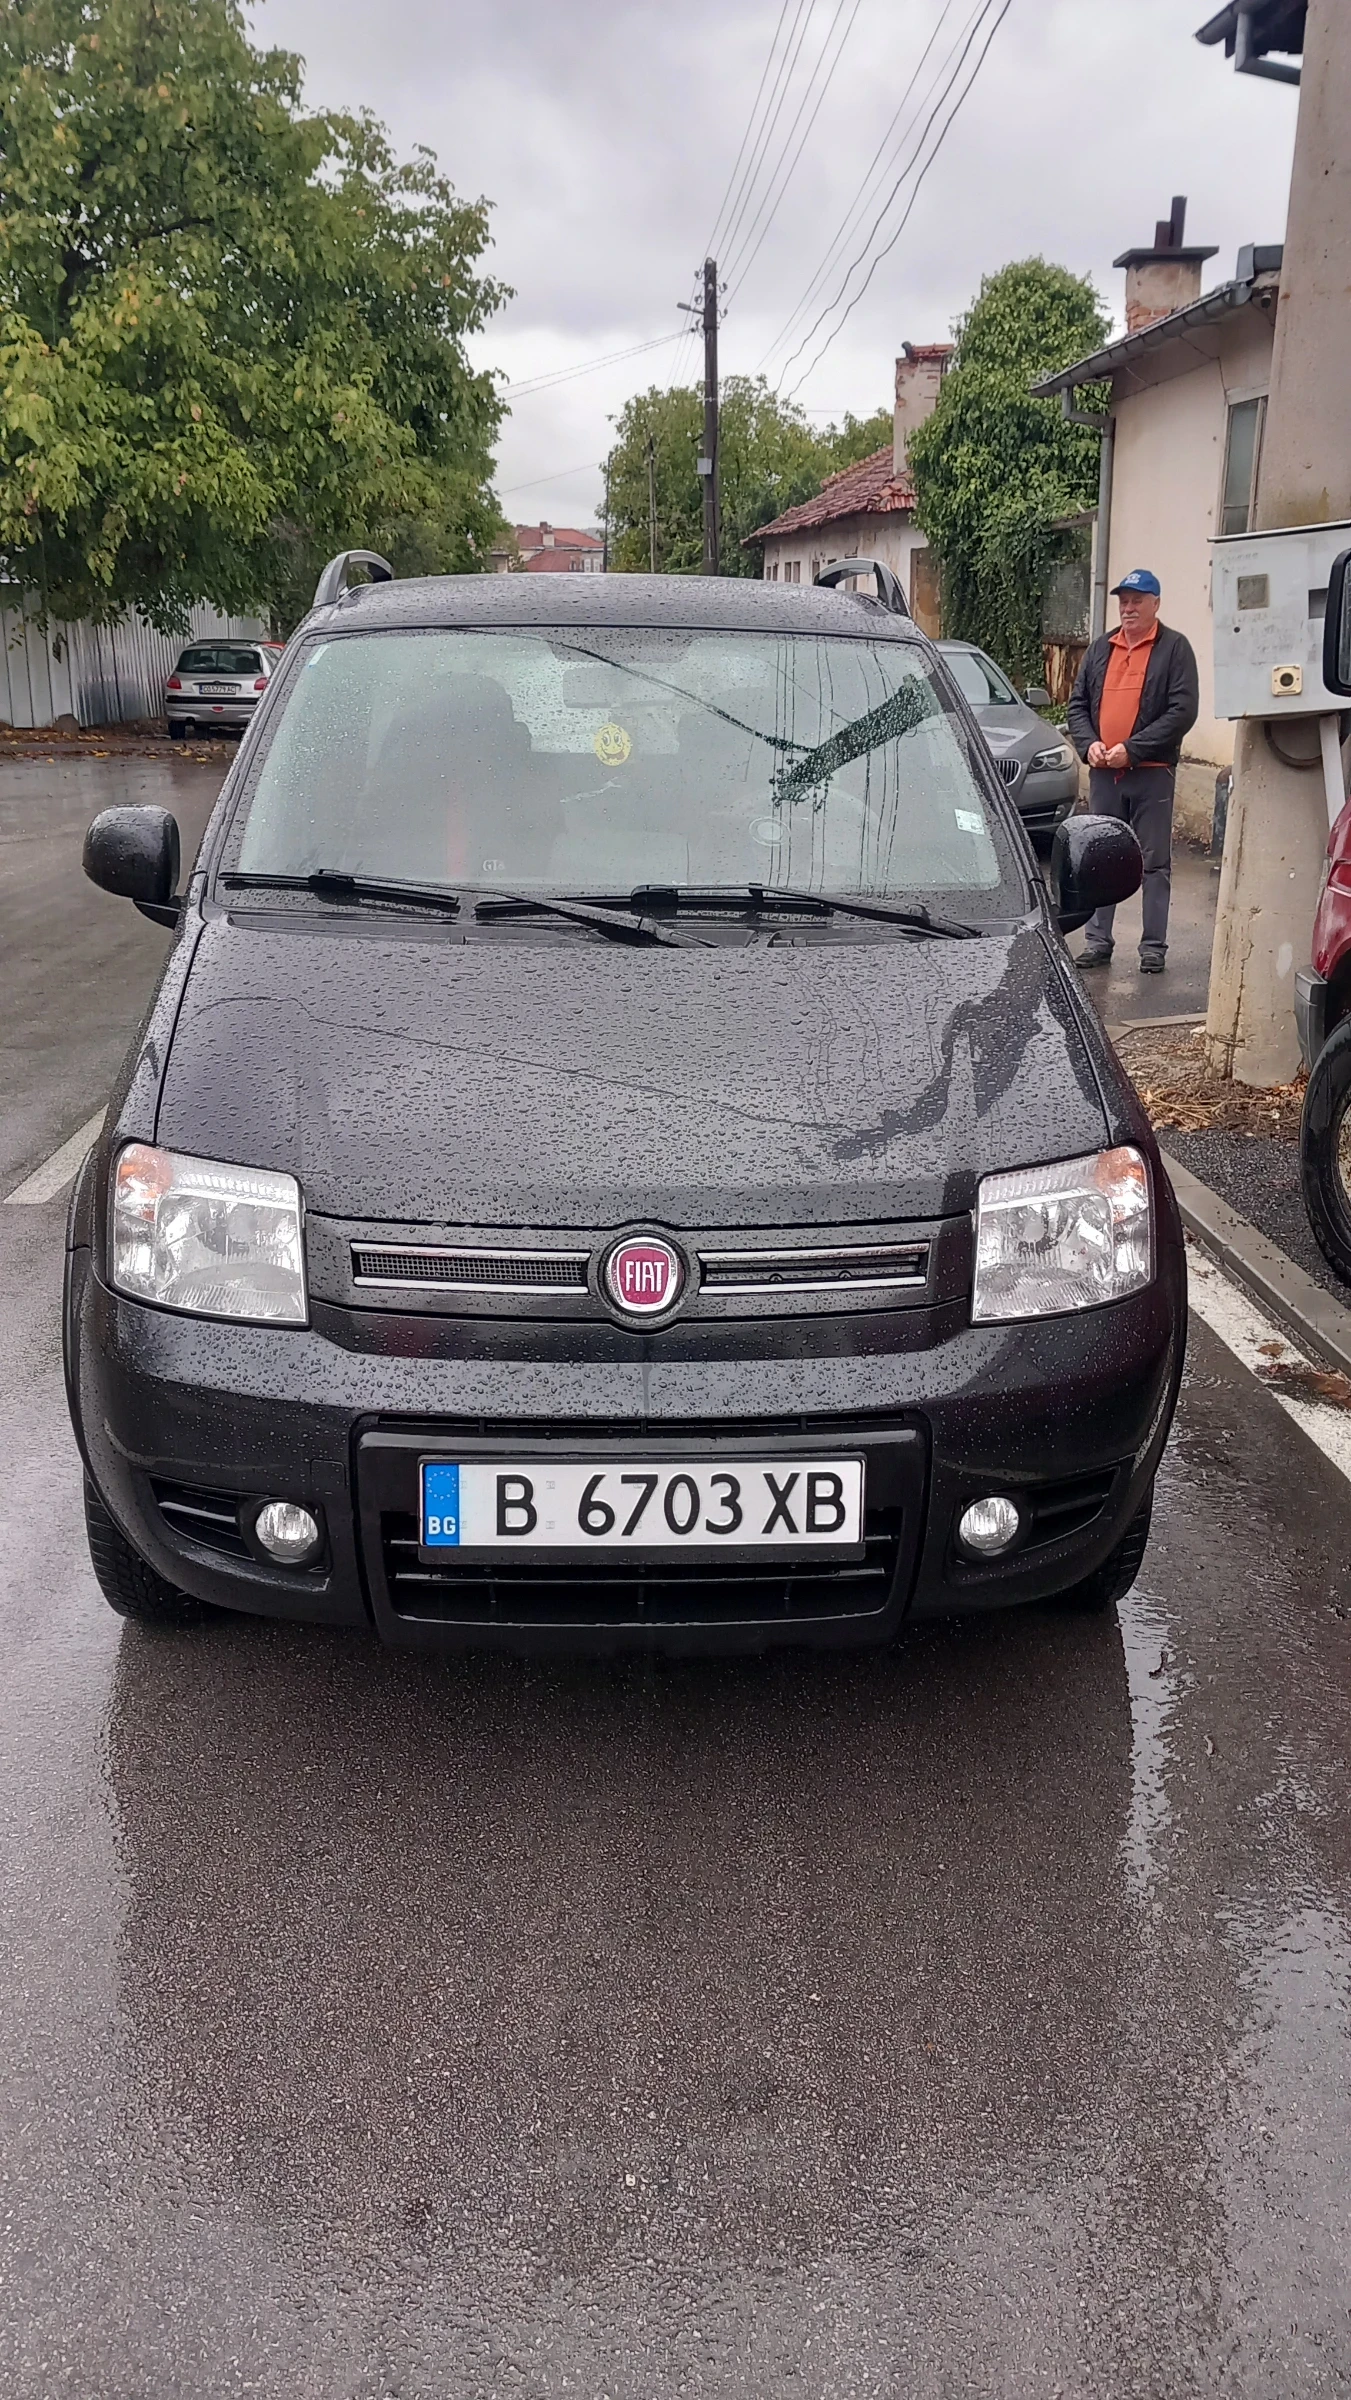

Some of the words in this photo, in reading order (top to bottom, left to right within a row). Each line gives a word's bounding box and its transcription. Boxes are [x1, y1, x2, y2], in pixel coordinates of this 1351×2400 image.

[625, 1260, 665, 1292] FIAT
[496, 1474, 537, 1536] B
[577, 1473, 743, 1536] 6703
[761, 1472, 846, 1534] XB
[428, 1516, 456, 1534] BG
